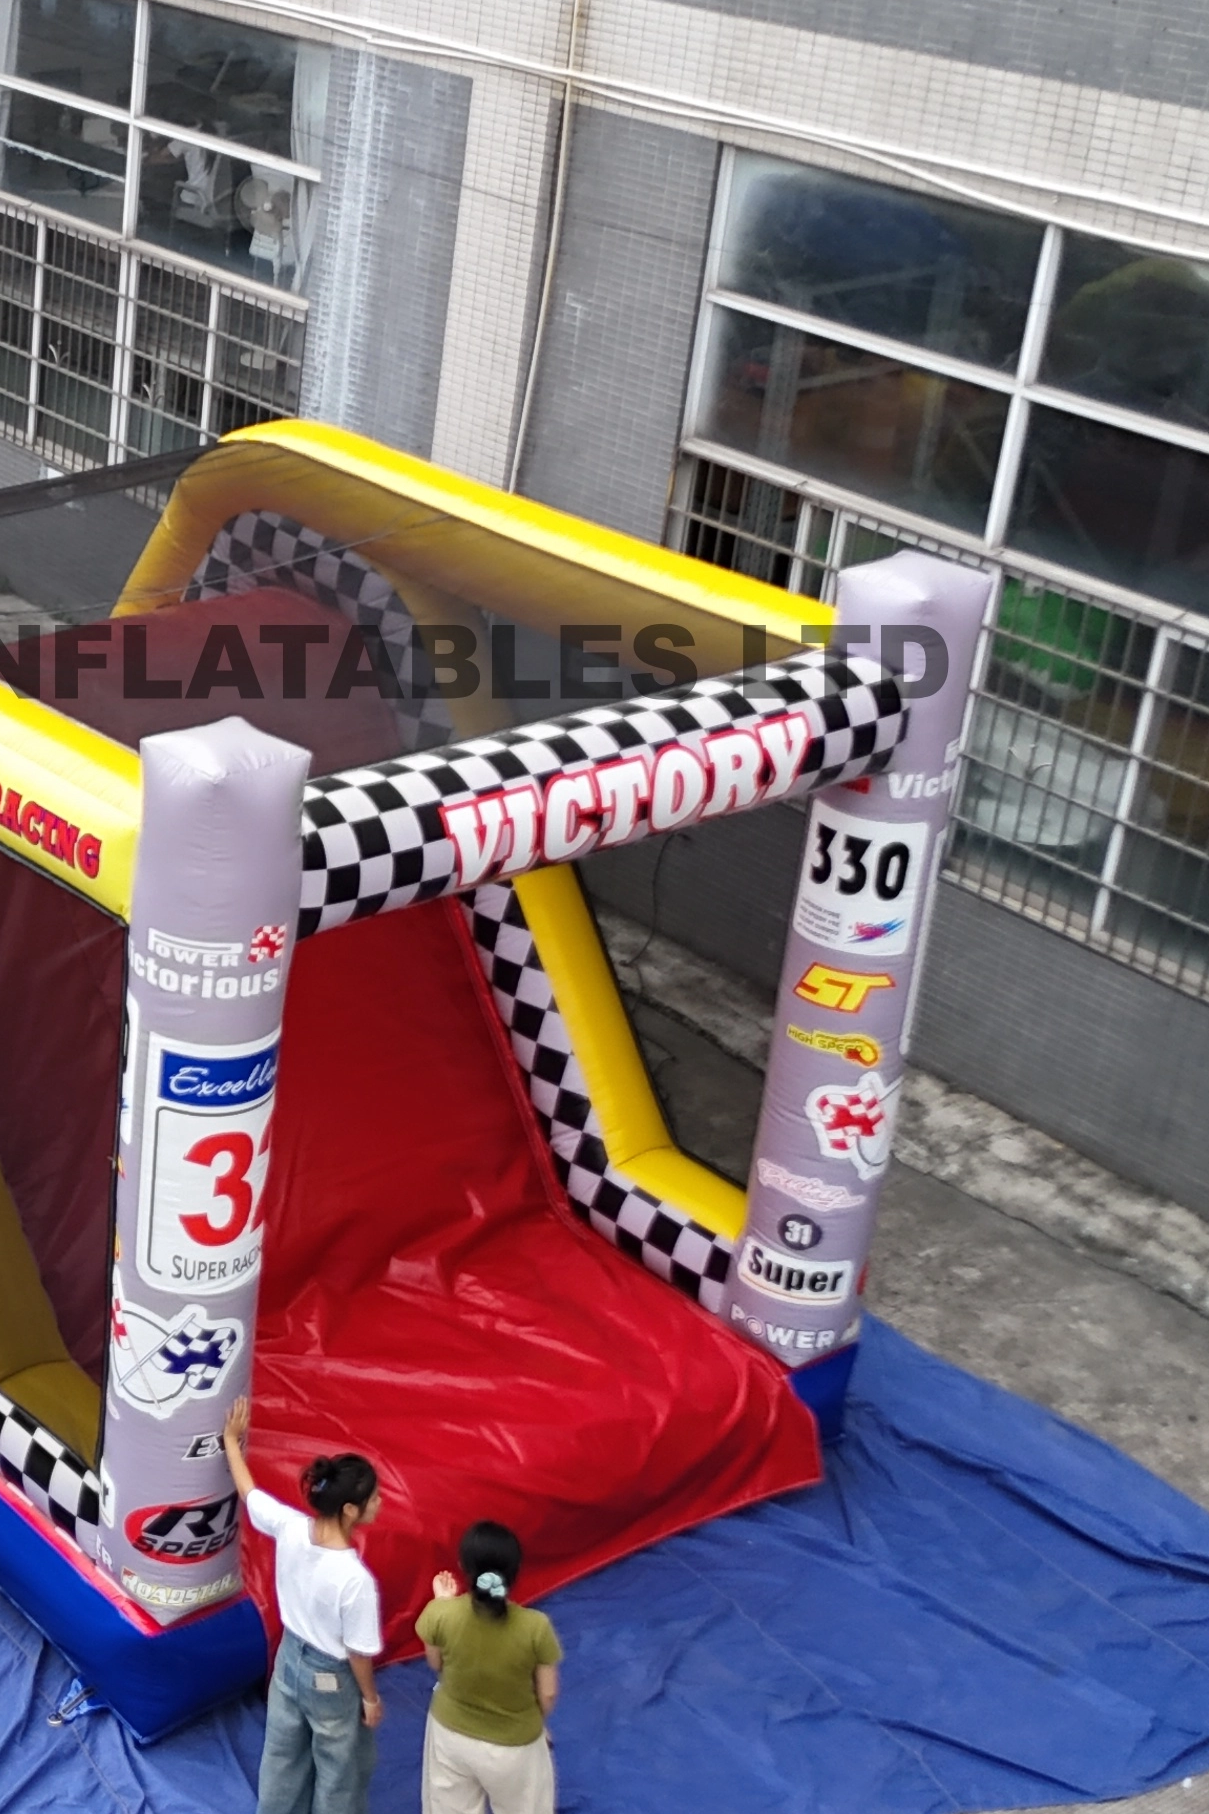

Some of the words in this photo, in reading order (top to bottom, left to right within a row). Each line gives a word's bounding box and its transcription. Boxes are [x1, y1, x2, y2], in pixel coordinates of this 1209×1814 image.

[439, 712, 811, 888] VICTORY
[809, 821, 910, 901] 330
[130, 938, 281, 999] ictorious
[147, 927, 244, 968] POWER
[792, 961, 897, 1014] ST
[788, 1028, 813, 1045] HIGH
[785, 1219, 812, 1246] 31
[171, 1254, 227, 1281] SUPER
[747, 1245, 843, 1293] Super
[730, 1302, 835, 1349] POWER
[121, 1567, 233, 1606] ROADSTER
